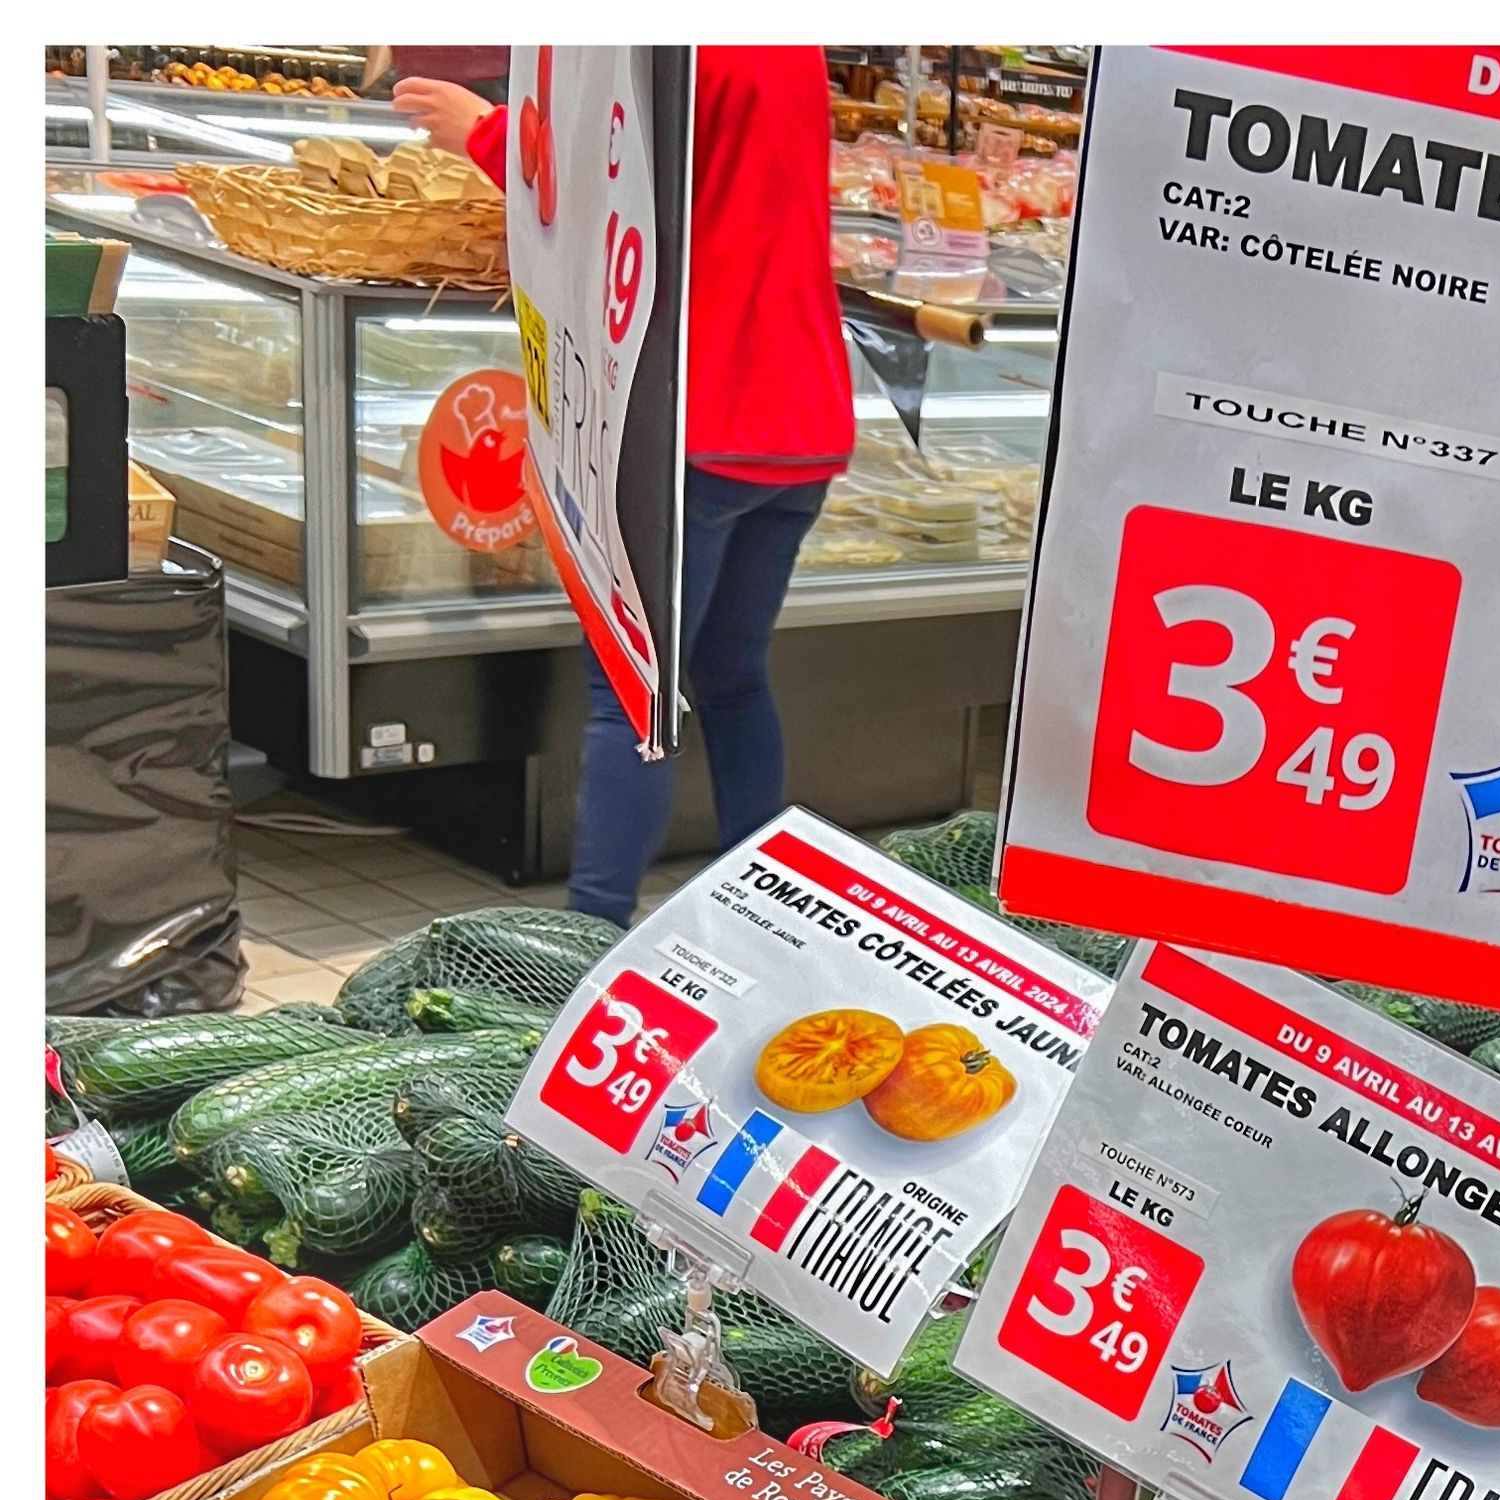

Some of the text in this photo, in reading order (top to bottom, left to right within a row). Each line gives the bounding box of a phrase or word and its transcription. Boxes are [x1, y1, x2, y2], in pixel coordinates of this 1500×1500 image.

[1162, 182, 1251, 219] CAT:2
[1158, 218, 1489, 304] VAR: CÔTELÉE NOIRE
[1186, 392, 1500, 466] TOUCHE N°337
[1229, 468, 1374, 526] LE KG
[451, 503, 534, 548] Préparé
[1129, 584, 1275, 786] 3
[1276, 726, 1395, 811] 49
[1477, 855, 1500, 873] DE
[671, 942, 713, 975] TOUCHE
[737, 862, 1000, 1019] TOMATES CÔTELÉES
[772, 929, 806, 949] JAUNE
[846, 882, 1068, 1014] DU 9 AVRIL AU 13 AVRIL 2024
[660, 966, 708, 1001] LE KG
[1122, 1041, 1162, 1069] CAT:2
[1138, 1001, 1319, 1120] TOMATES
[608, 1073, 653, 1114] 49
[1116, 1056, 1274, 1149] VAR: ALLONGÉE COEUR
[1276, 1022, 1310, 1052] DU
[1314, 1040, 1331, 1062] 9
[1333, 1055, 1403, 1104] AVRIL
[1406, 1096, 1443, 1125] AU
[1446, 1115, 1477, 1140] 13
[660, 1134, 692, 1160] TOMATES
[663, 1148, 687, 1168] FRANCE
[1099, 1142, 1196, 1202] TOUCHE N°573
[902, 1180, 969, 1227] ORIGINE
[1109, 1179, 1175, 1228] LE KG
[787, 1169, 953, 1324] FRANCE
[1026, 1229, 1112, 1337] 3
[1090, 1320, 1150, 1374] 49
[1171, 1412, 1219, 1446] DE FRANCE
[1175, 1401, 1224, 1438] TOMATES
[725, 1467, 755, 1491] de
[749, 1447, 797, 1479] Les
